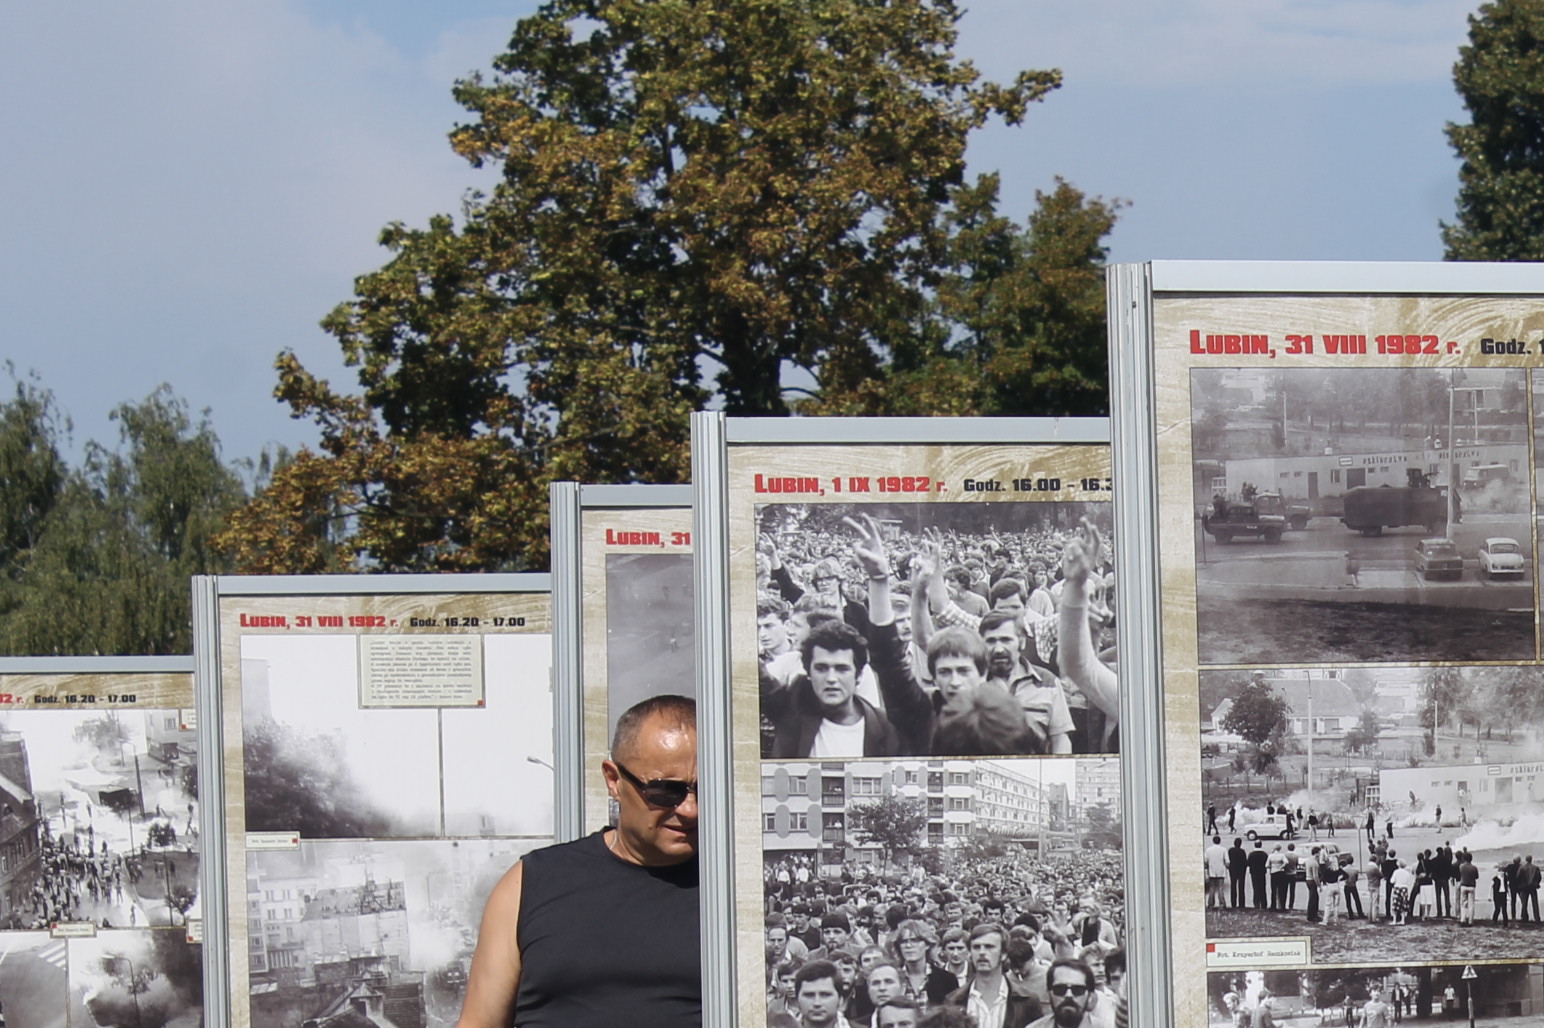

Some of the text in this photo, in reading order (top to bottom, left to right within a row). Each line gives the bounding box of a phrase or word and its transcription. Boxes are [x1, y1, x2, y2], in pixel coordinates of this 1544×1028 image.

[1285, 335, 1314, 354] 31
[1322, 334, 1367, 354] VIII
[1375, 334, 1439, 354] 1982
[1446, 341, 1461, 354] r.
[1481, 338, 1532, 354] Godz.
[832, 477, 841, 492] 1
[850, 477, 870, 492] IX
[877, 476, 930, 492] 1982
[937, 481, 948, 492] r.
[964, 478, 1005, 492] Godz.
[1012, 478, 1061, 492] 16.00
[1081, 478, 1112, 491] 16.3
[671, 532, 690, 545] 31
[295, 616, 312, 627] 31
[318, 616, 343, 627] VIII
[348, 616, 386, 627] 1982
[390, 618, 398, 627] r.
[410, 617, 440, 627] Godz.
[445, 617, 479, 627] 16.20
[493, 617, 525, 627] 17.00
[34, 694, 61, 704] Godz.
[65, 694, 95, 703] 16.20
[107, 694, 136, 703] 17.00
